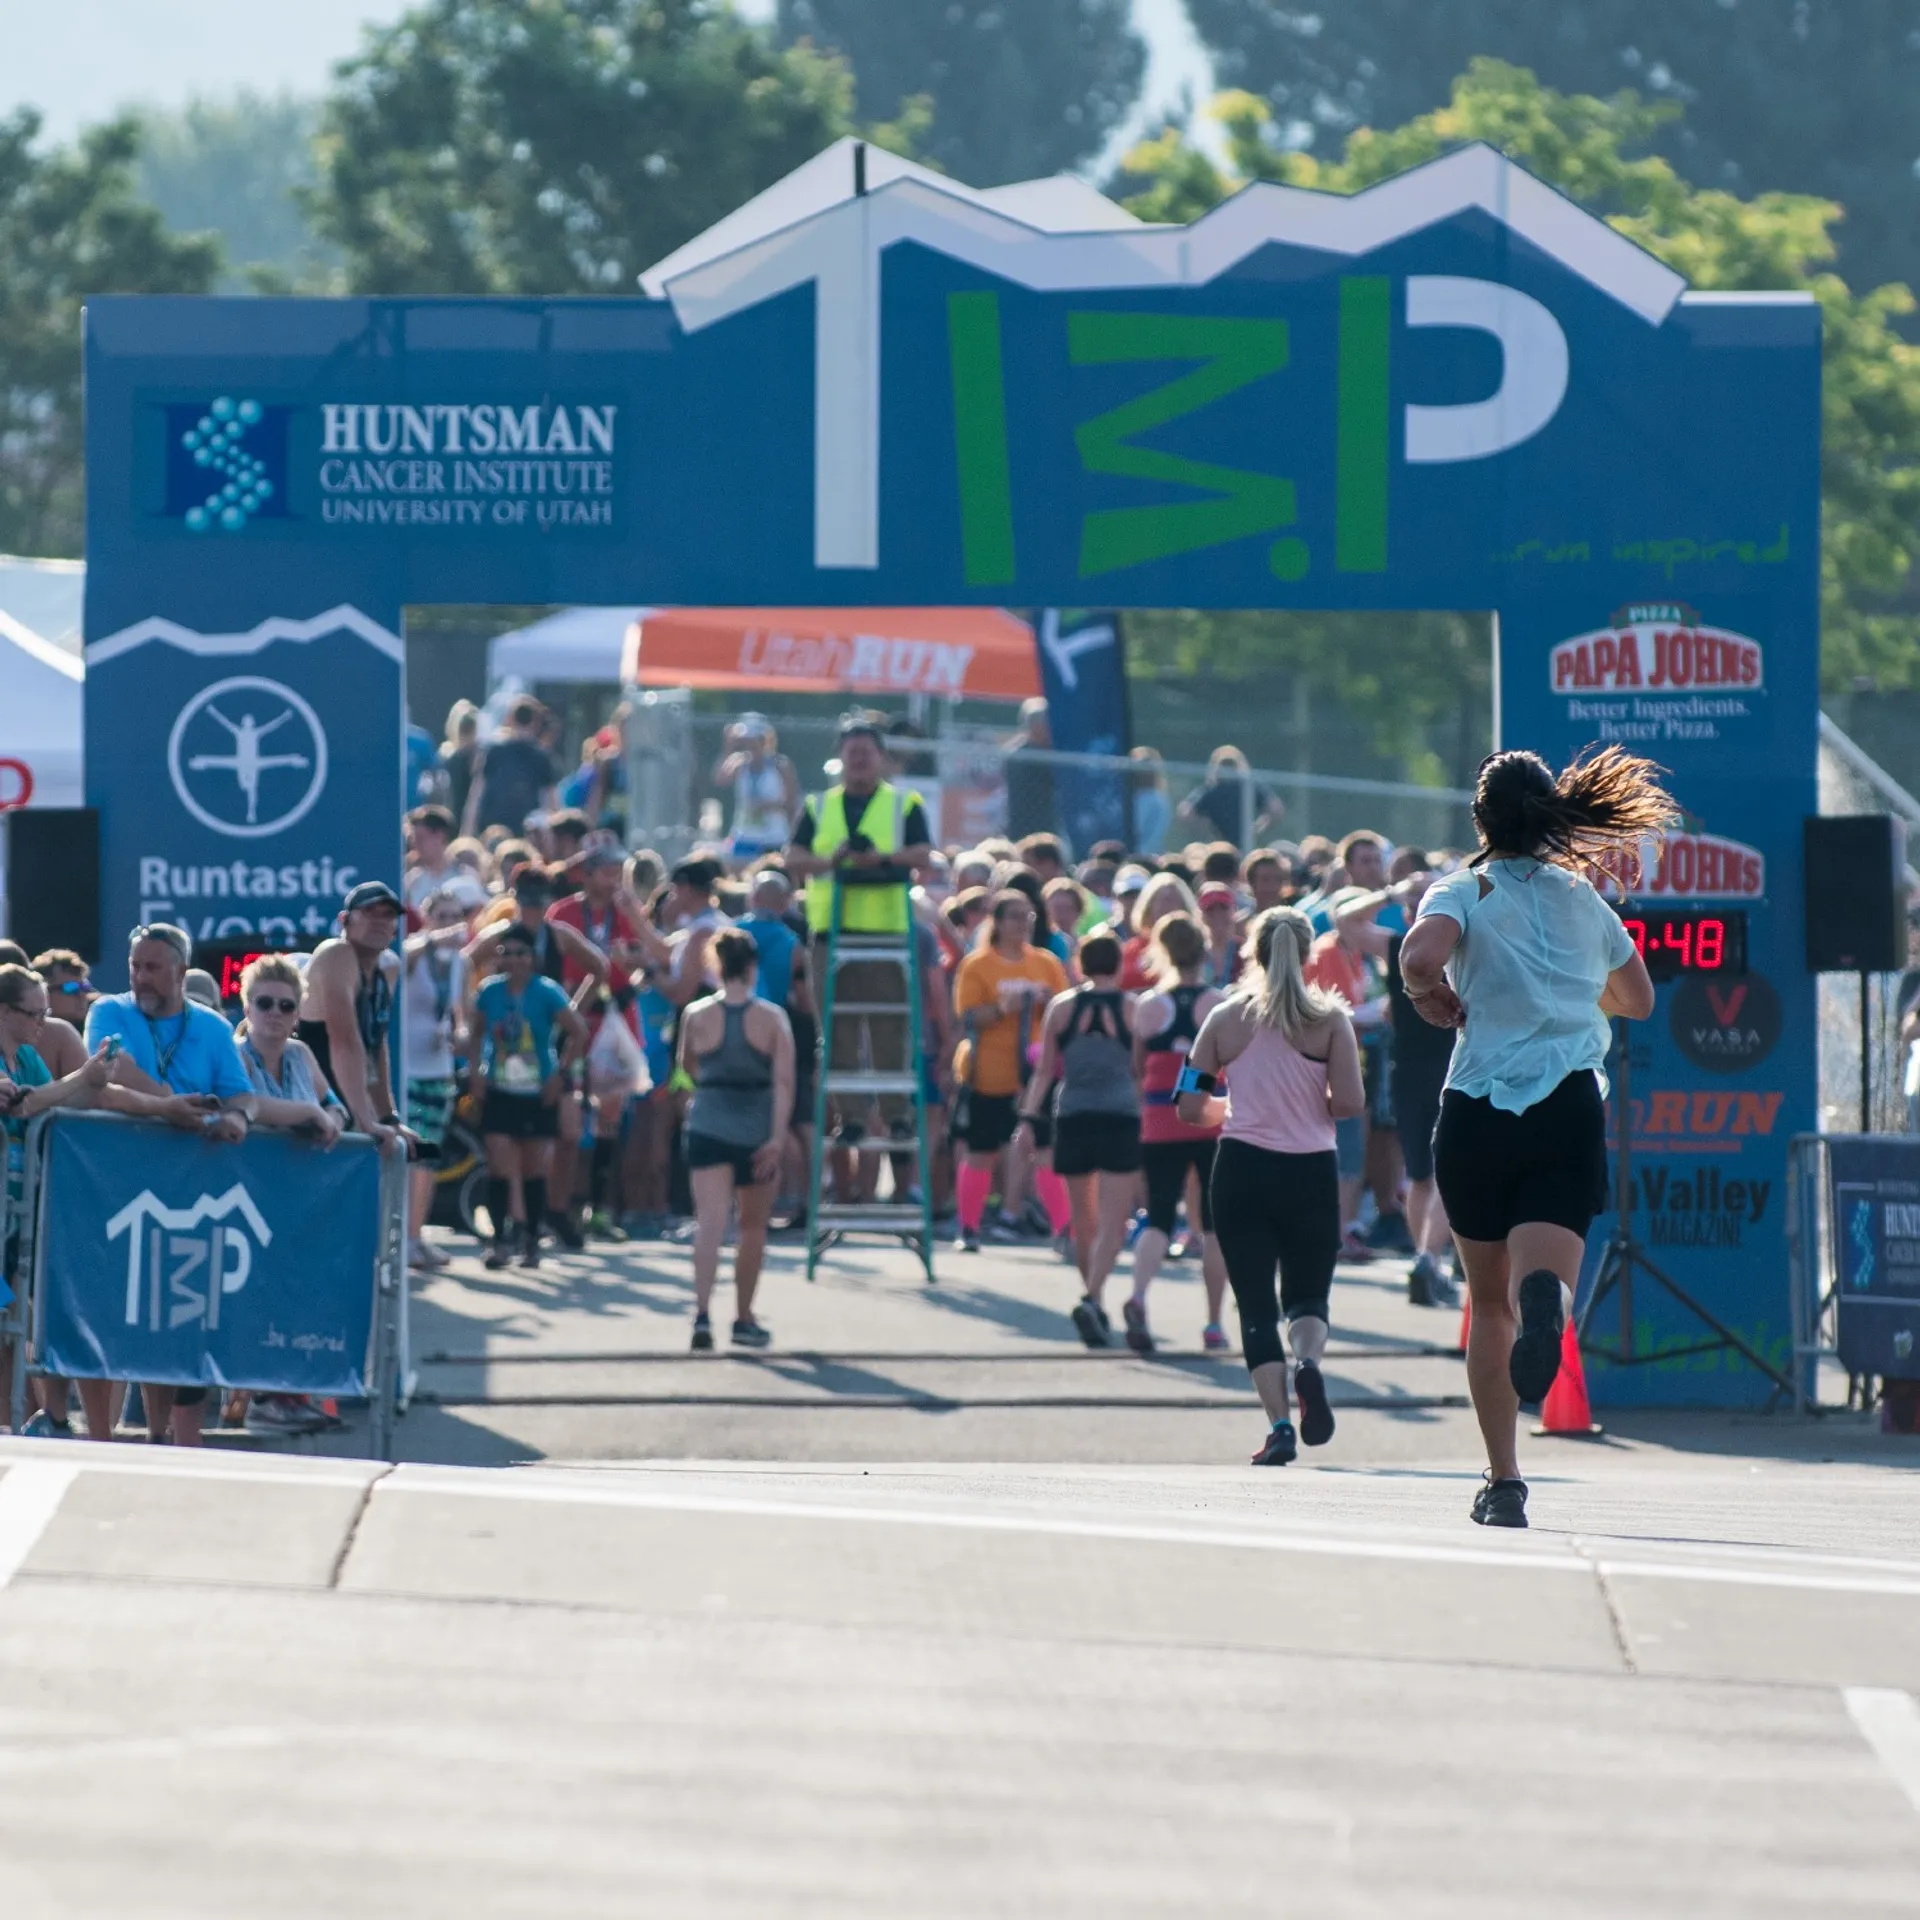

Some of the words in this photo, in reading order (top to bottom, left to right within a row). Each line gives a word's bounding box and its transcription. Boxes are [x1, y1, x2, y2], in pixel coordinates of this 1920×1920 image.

[321, 404, 615, 453] HUNTSMAN
[320, 460, 446, 494] CANCER
[453, 460, 614, 494] INSTITUTE
[321, 500, 486, 525] UNIVERSITY
[491, 500, 529, 524] OF
[536, 500, 613, 525] UTAH
[1611, 523, 1789, 580] inspired
[1627, 604, 1682, 622] PIZZA
[737, 629, 974, 690] UtahRUN
[1555, 633, 1643, 689] PAPA
[1568, 699, 1628, 720] Better
[1633, 697, 1750, 723] Ingredients.
[1600, 721, 1659, 740] Better
[1665, 720, 1720, 741] Pizza.
[139, 857, 358, 898] Runtastic
[1693, 1028, 1761, 1045] VASA
[1652, 1217, 1741, 1247] MAGAZINE
